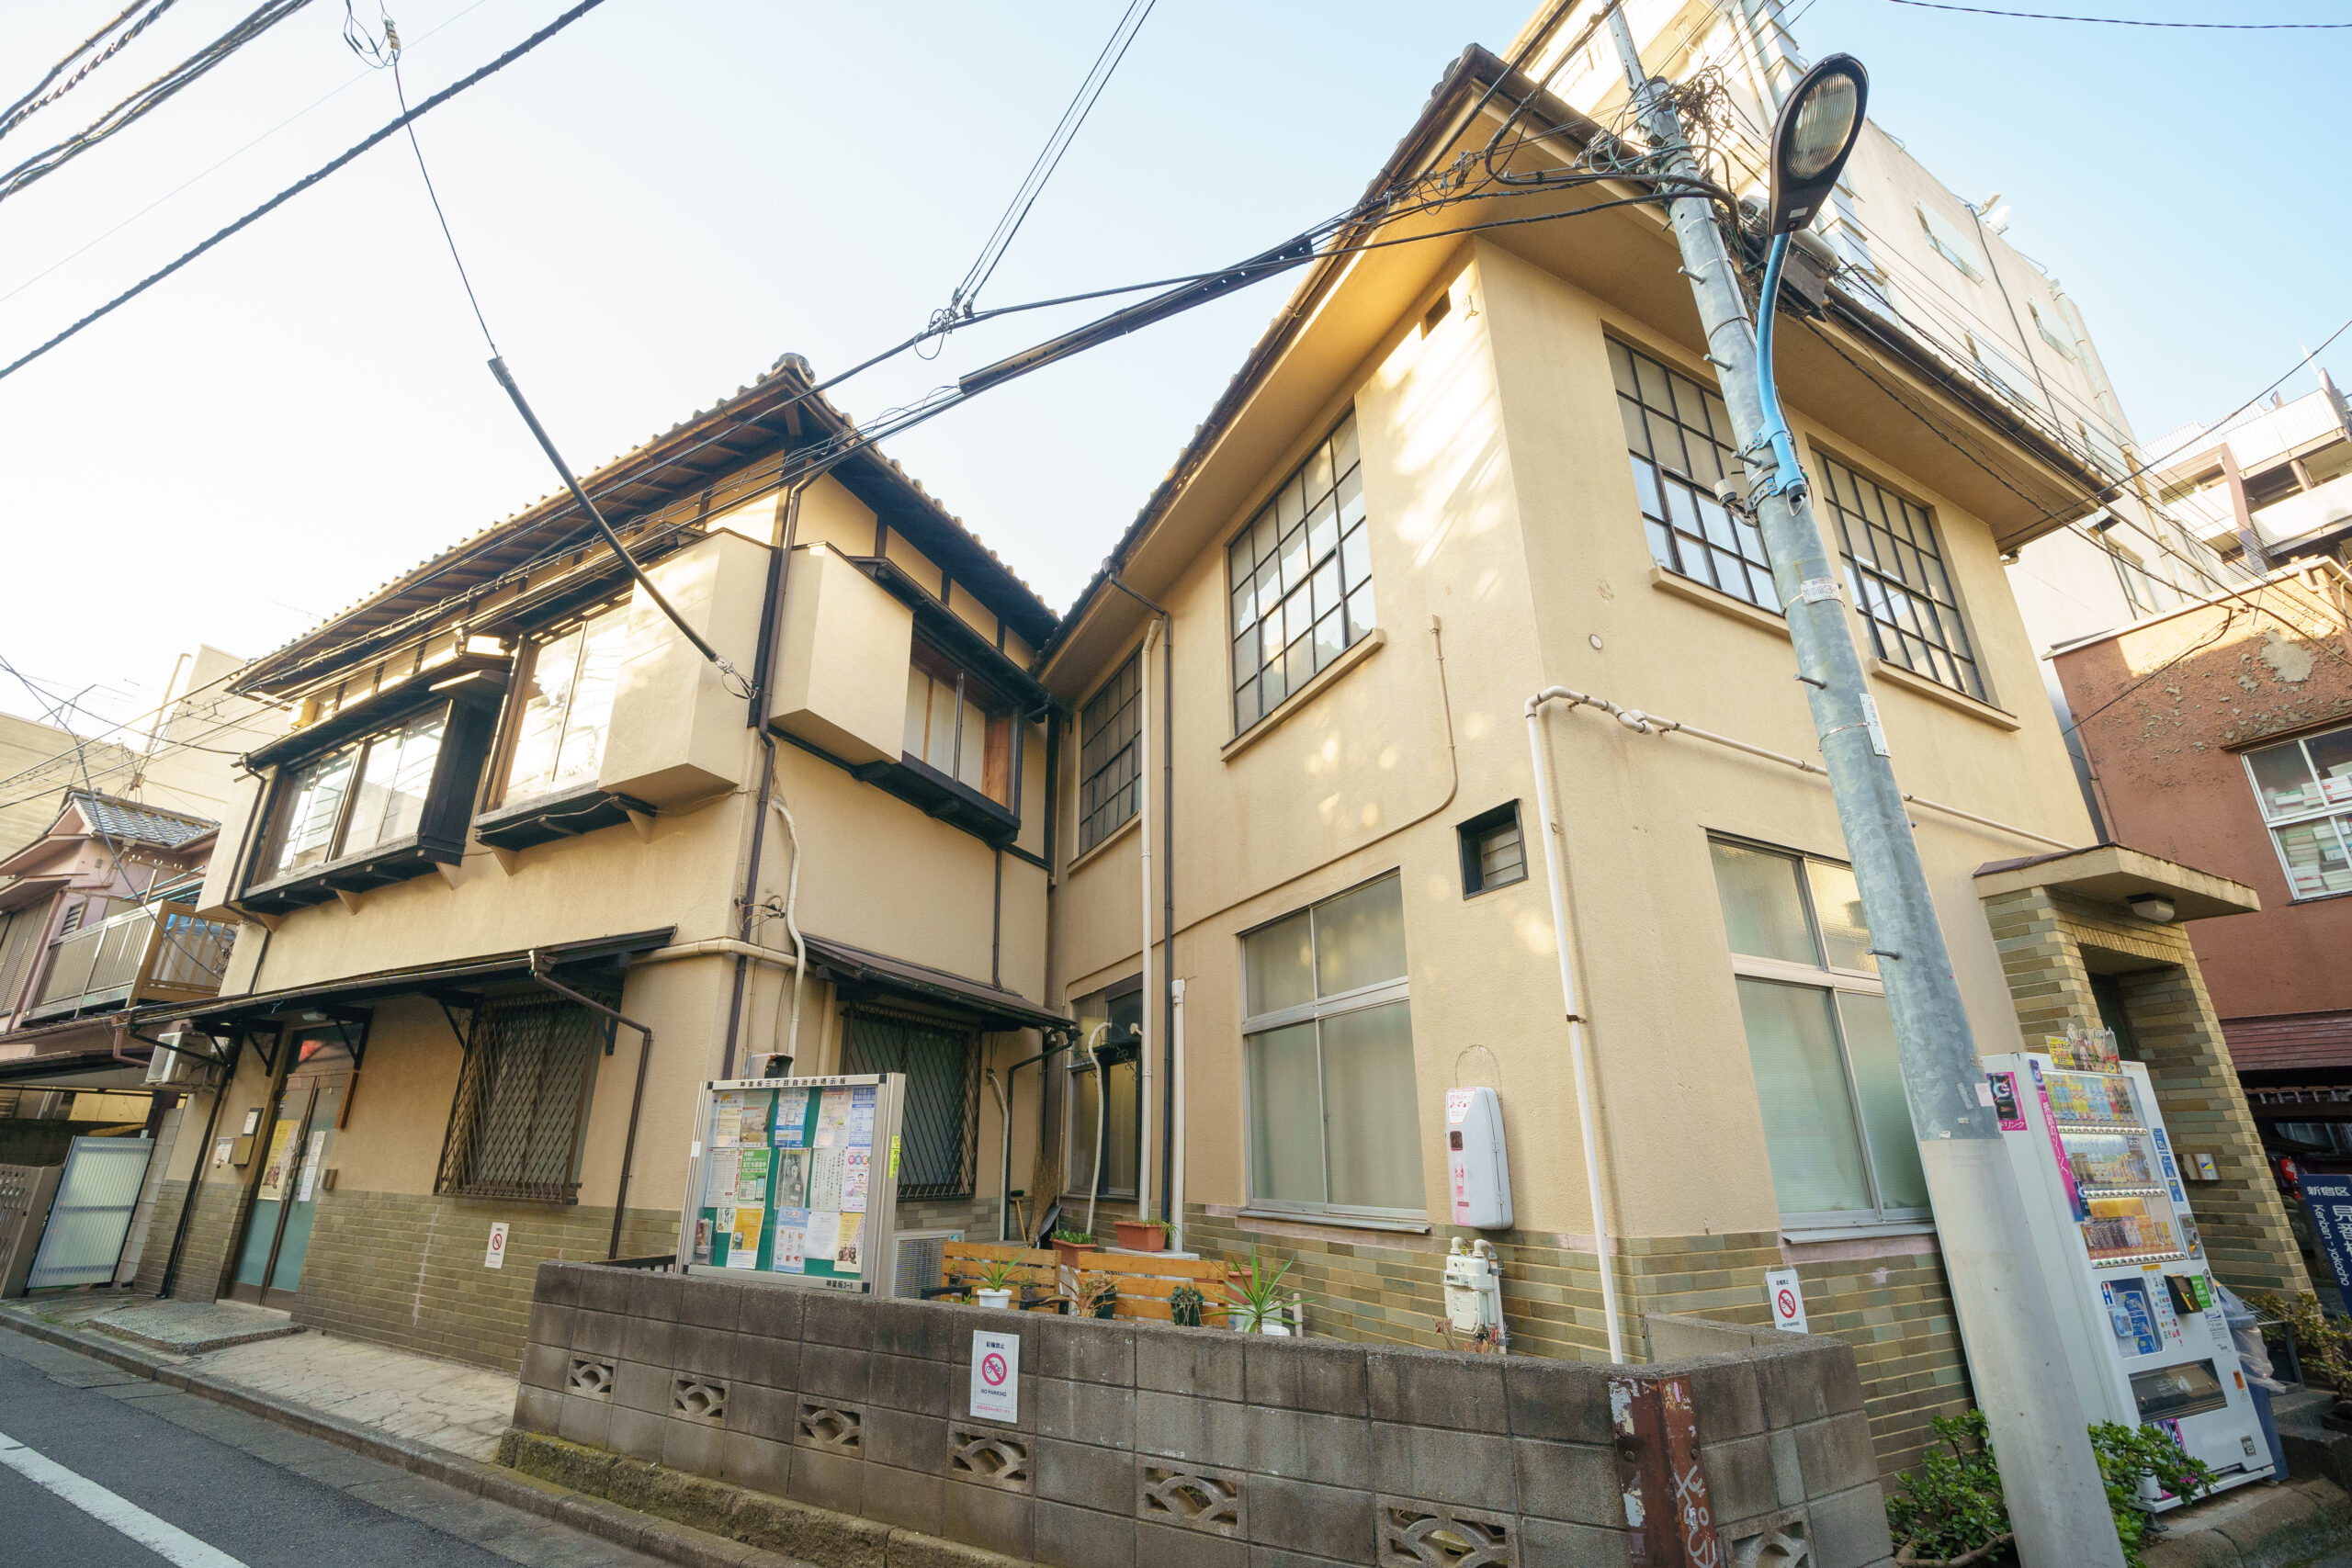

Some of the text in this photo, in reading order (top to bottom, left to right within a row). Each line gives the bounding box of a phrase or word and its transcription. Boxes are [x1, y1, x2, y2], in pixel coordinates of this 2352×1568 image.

[2306, 1185, 2350, 1196] 新宿区
[2312, 1204, 2333, 1240] Kenban
[2326, 1247, 2350, 1286] yokocho
